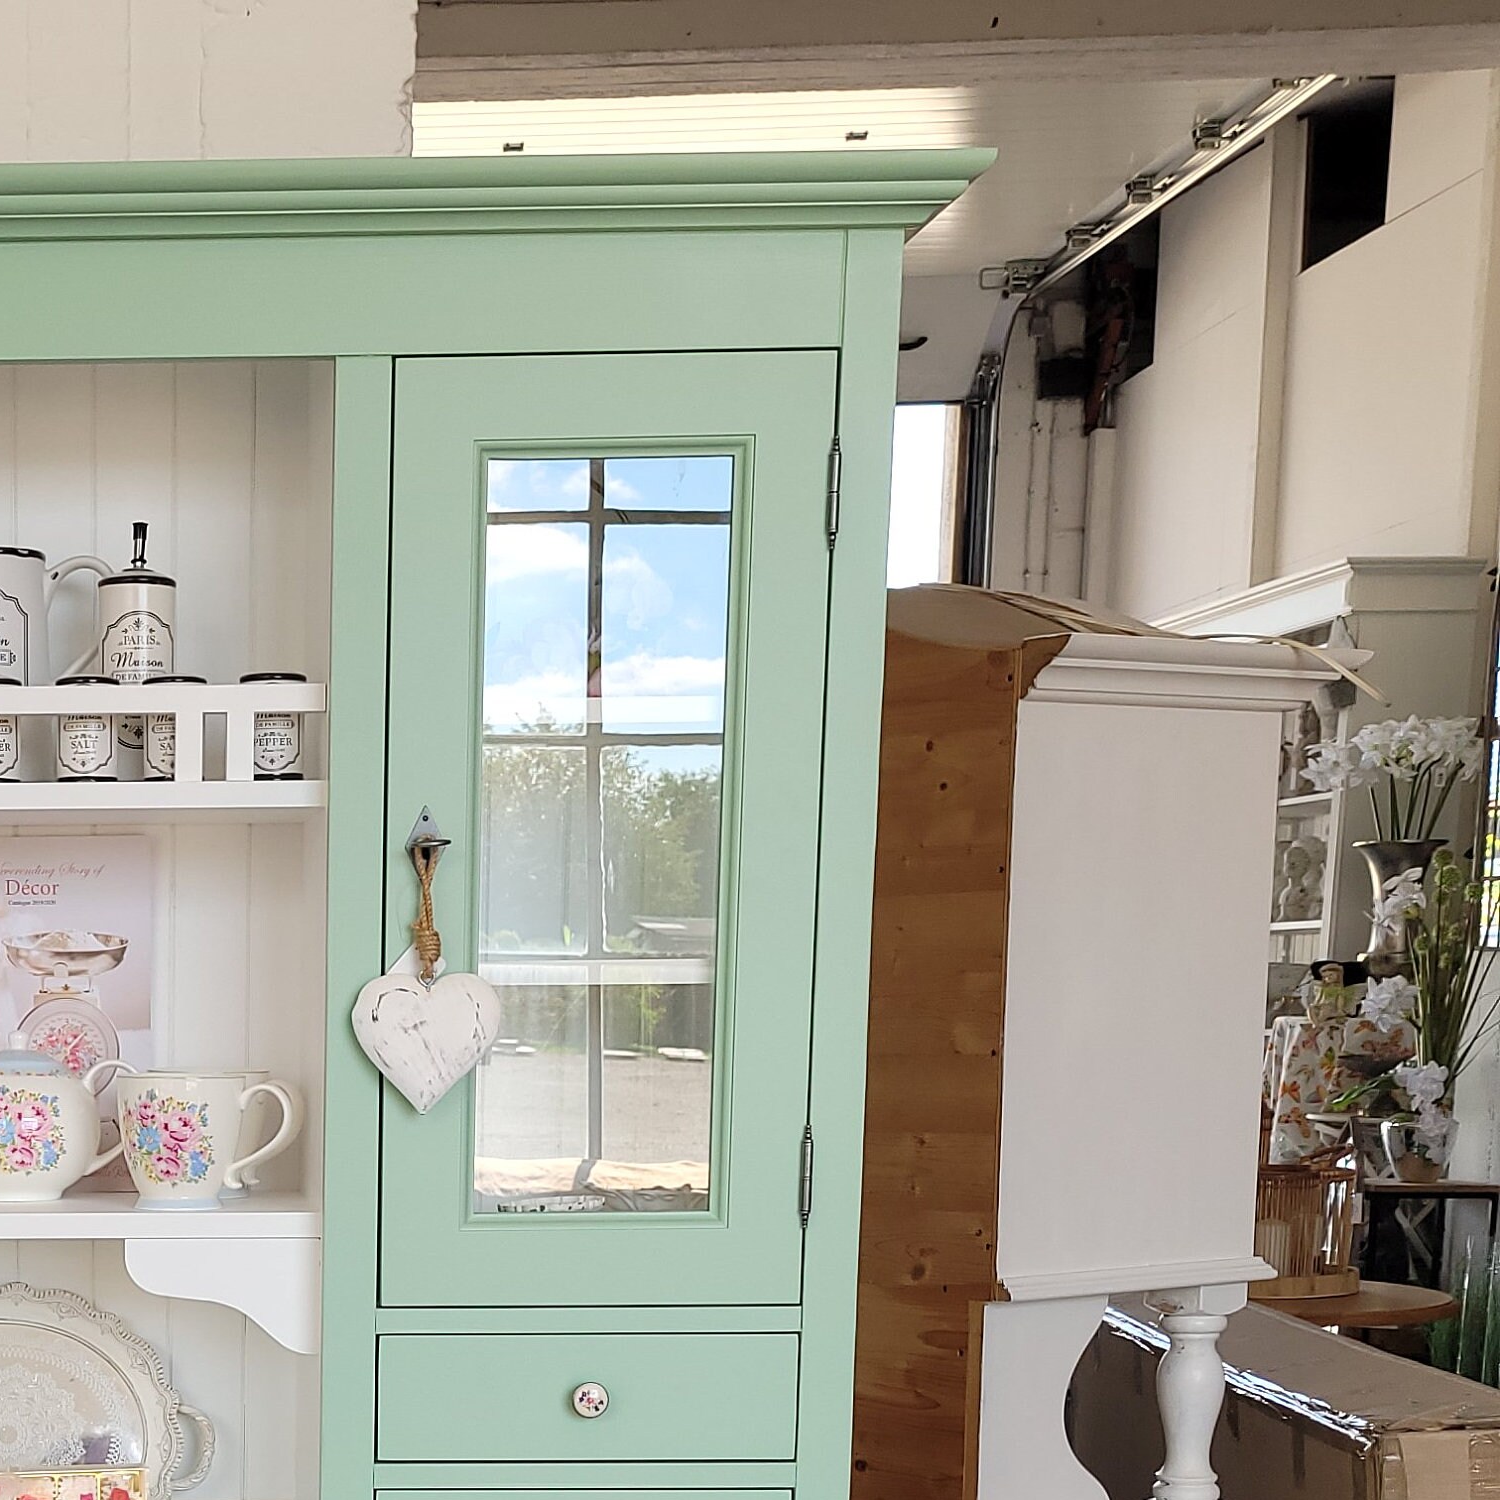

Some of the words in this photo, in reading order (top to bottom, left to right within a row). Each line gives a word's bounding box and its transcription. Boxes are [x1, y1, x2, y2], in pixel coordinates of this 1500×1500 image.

[124, 635, 156, 645] PARIS
[110, 651, 164, 668] Maison
[71, 740, 98, 749] SALT
[58, 861, 90, 879] Story
[5, 879, 60, 896] Décor
